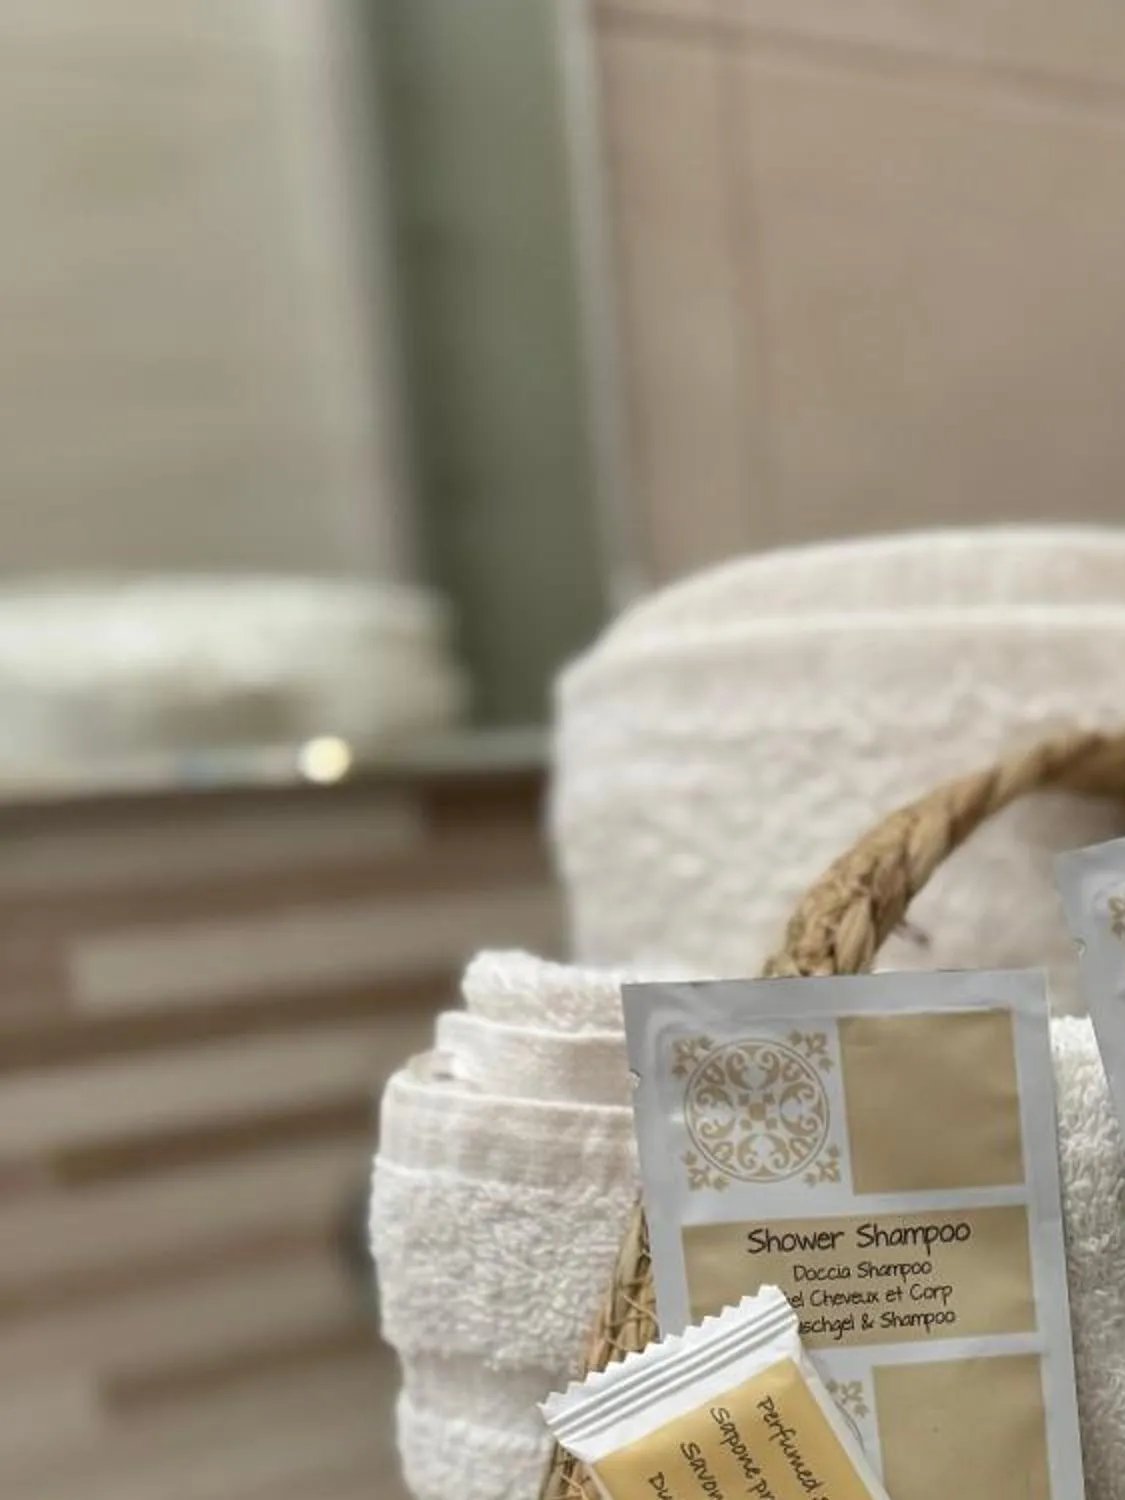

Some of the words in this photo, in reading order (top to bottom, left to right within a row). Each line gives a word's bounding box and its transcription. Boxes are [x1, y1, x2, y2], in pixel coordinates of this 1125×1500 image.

[747, 1226, 845, 1254] Shower
[856, 1222, 971, 1256] Shampoo
[793, 1263, 851, 1281] Doccia
[857, 1260, 932, 1286] Shampoo
[784, 1291, 804, 1308] el
[811, 1289, 878, 1307] Cheveux
[886, 1286, 903, 1302] et
[910, 1284, 952, 1305] Corp
[799, 1316, 855, 1340] schgel
[861, 1314, 873, 1330] &
[880, 1311, 956, 1333] Shampoo
[710, 1407, 760, 1478] Sapone
[757, 1396, 821, 1493] Perfumed
